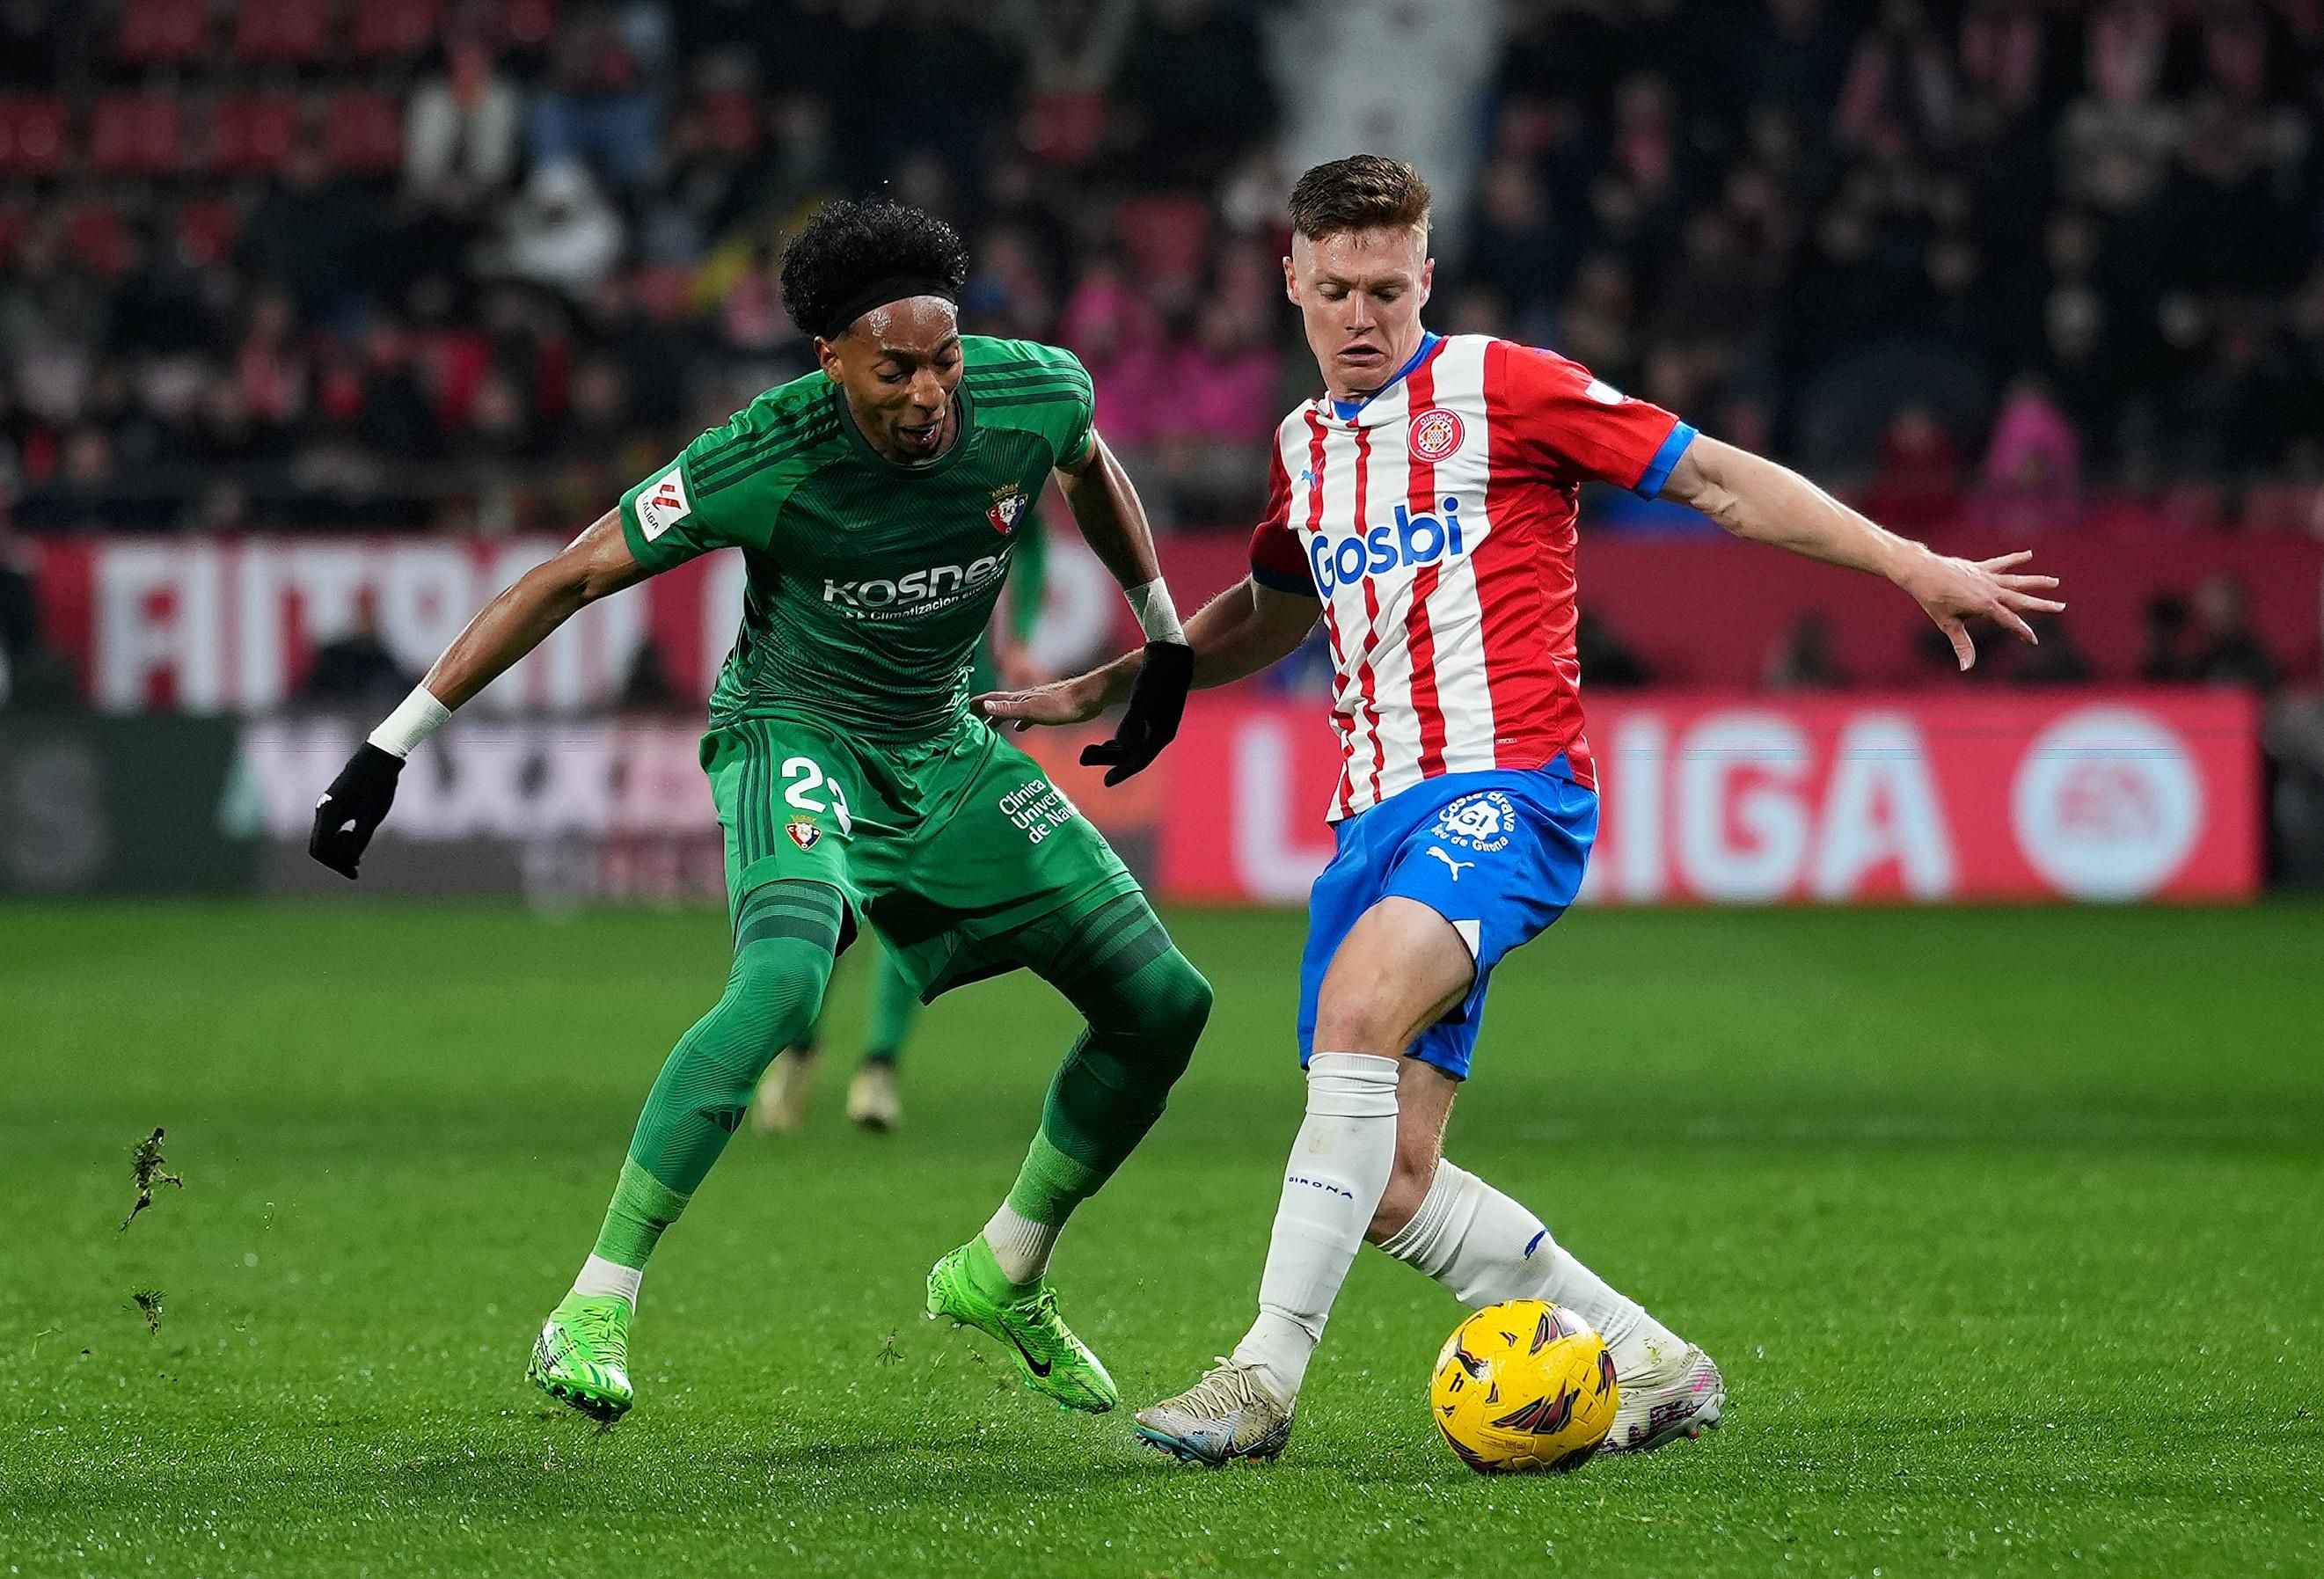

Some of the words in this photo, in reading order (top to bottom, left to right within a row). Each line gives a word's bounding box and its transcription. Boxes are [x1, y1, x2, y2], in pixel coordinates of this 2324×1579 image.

[1419, 413, 1454, 427] GIRONA
[642, 495, 660, 530] LALIGA
[1311, 497, 1463, 599] Gosbi
[1028, 823, 1051, 844] de
[1451, 836, 1468, 847] de
